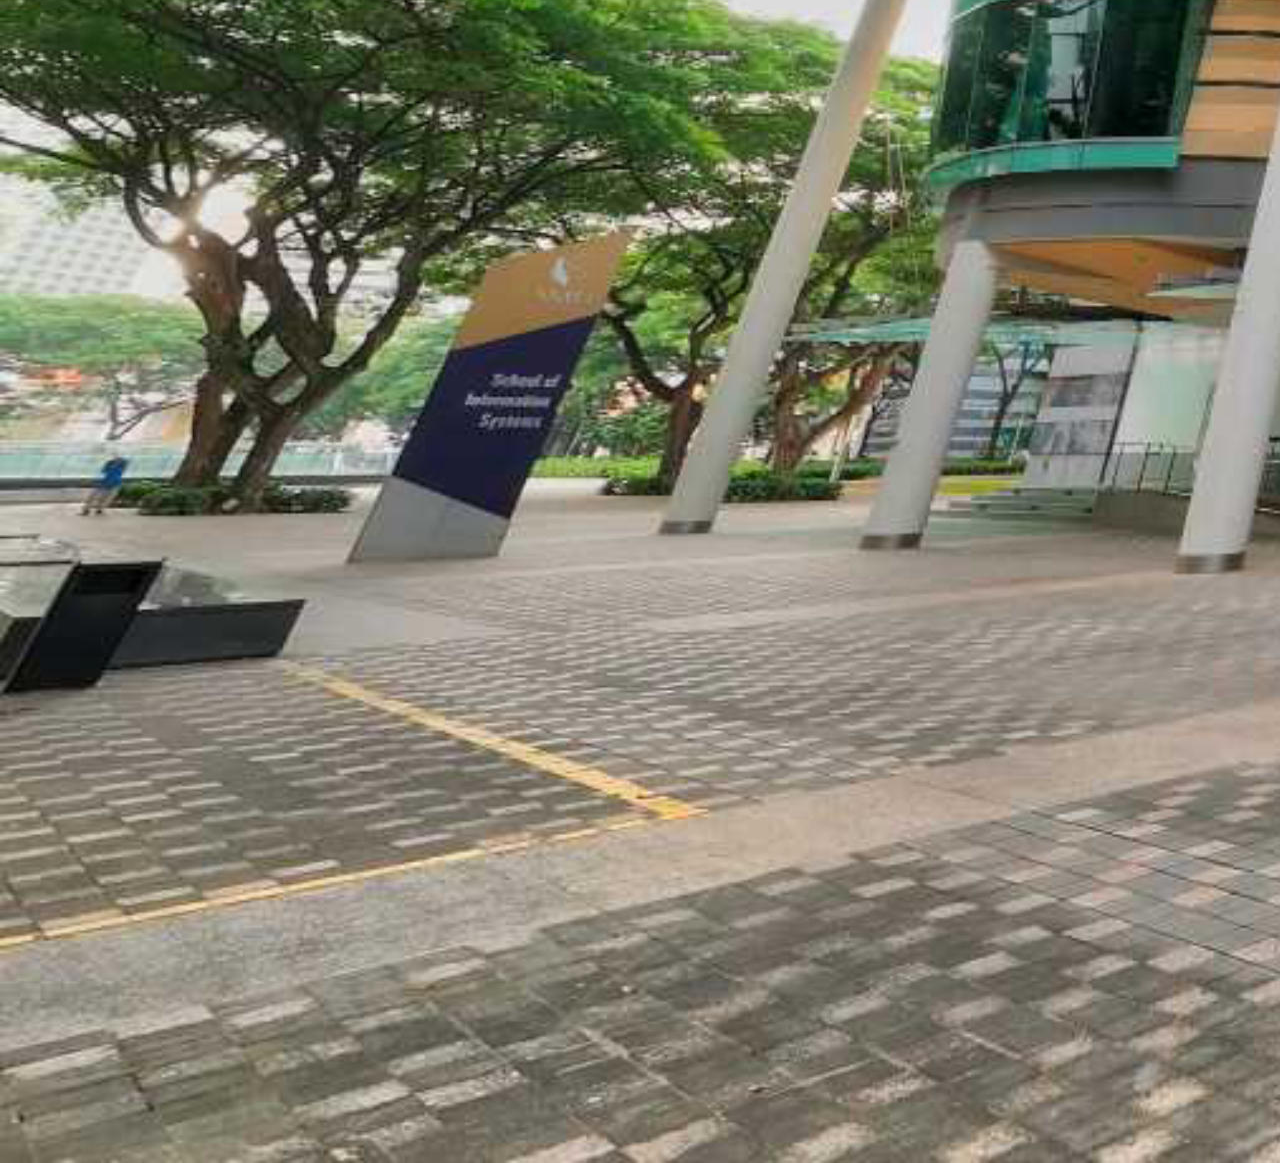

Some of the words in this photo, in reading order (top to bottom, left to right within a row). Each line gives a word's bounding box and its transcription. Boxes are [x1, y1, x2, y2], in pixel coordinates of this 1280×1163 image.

[491, 373, 544, 388] School
[544, 373, 562, 388] of
[477, 413, 542, 430] Systems
